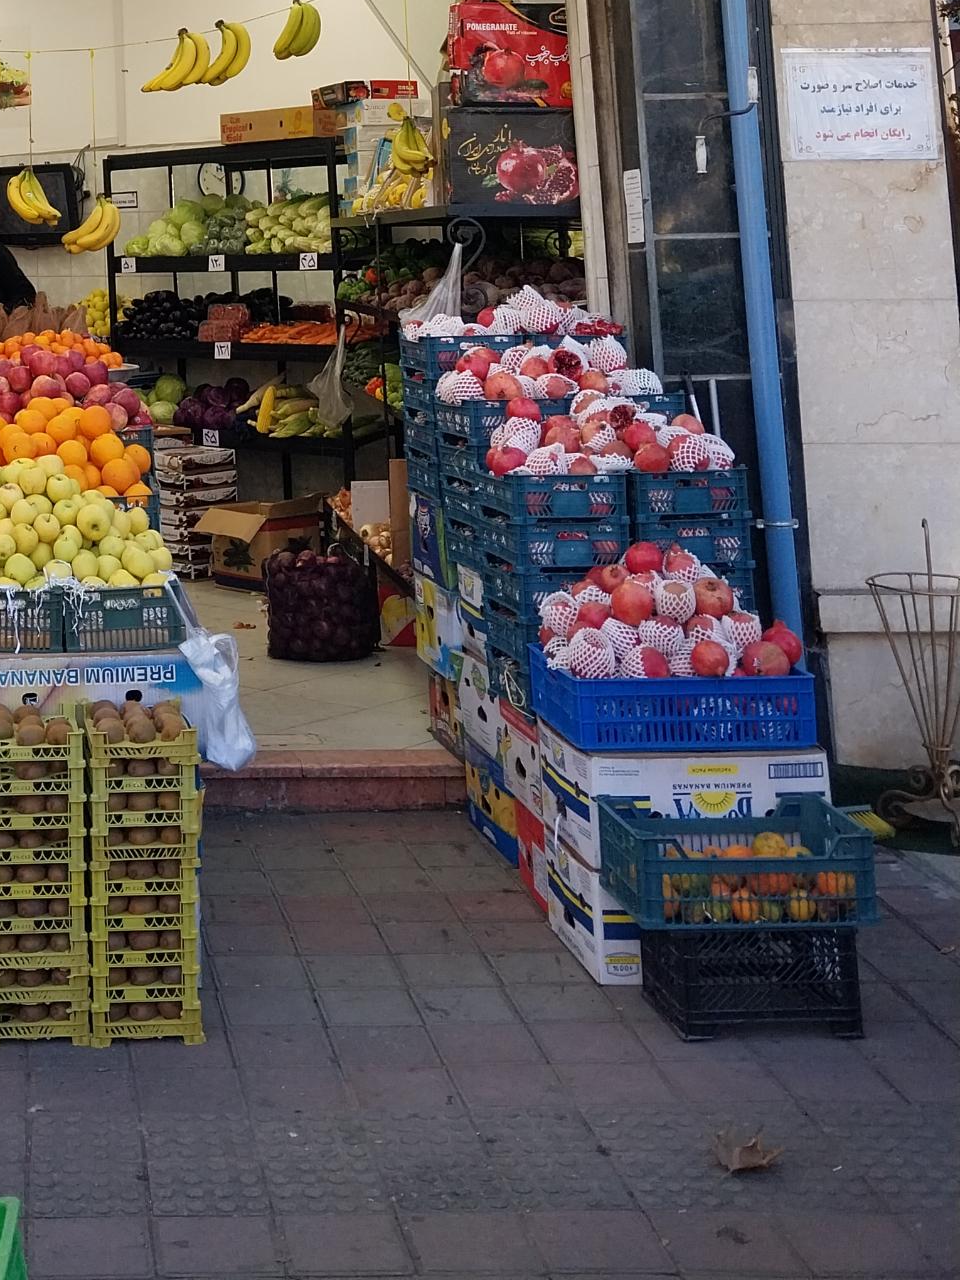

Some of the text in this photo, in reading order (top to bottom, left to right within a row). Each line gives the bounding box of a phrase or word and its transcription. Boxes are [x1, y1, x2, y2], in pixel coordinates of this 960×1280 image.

[466, 22, 517, 31] POMEGRANATE
[800, 82, 829, 93] صورت
[856, 80, 882, 91] اصلاح
[885, 78, 917, 89] خدمات
[820, 102, 901, 117] برای افراد نیازمند
[815, 131, 834, 141] شود
[854, 128, 878, 140] انجام
[880, 127, 911, 140] رایگان
[85, 665, 177, 684] PREMIUM
